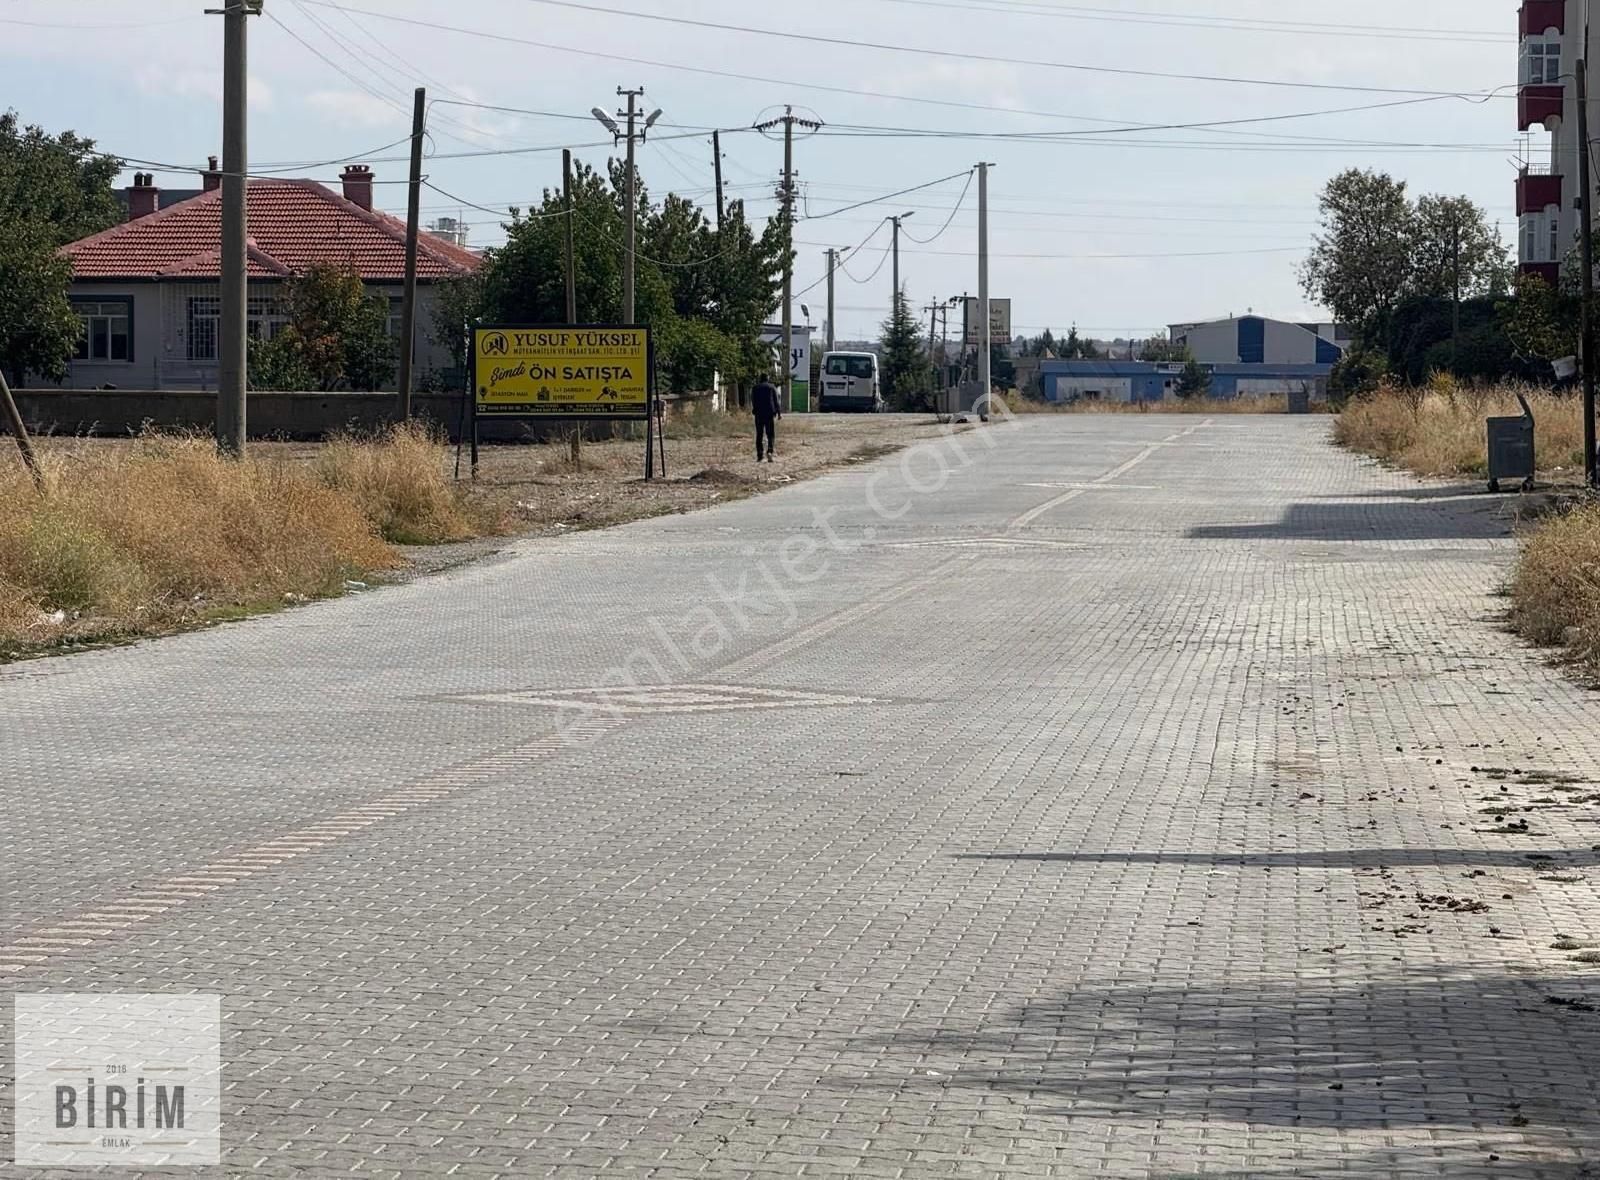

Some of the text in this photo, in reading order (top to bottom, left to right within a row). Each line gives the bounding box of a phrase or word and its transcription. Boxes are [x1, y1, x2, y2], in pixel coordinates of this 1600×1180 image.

[514, 331, 641, 346] YUSUF YÜKSEL
[490, 360, 633, 387] Şimdi ÖN SATIŞTA
